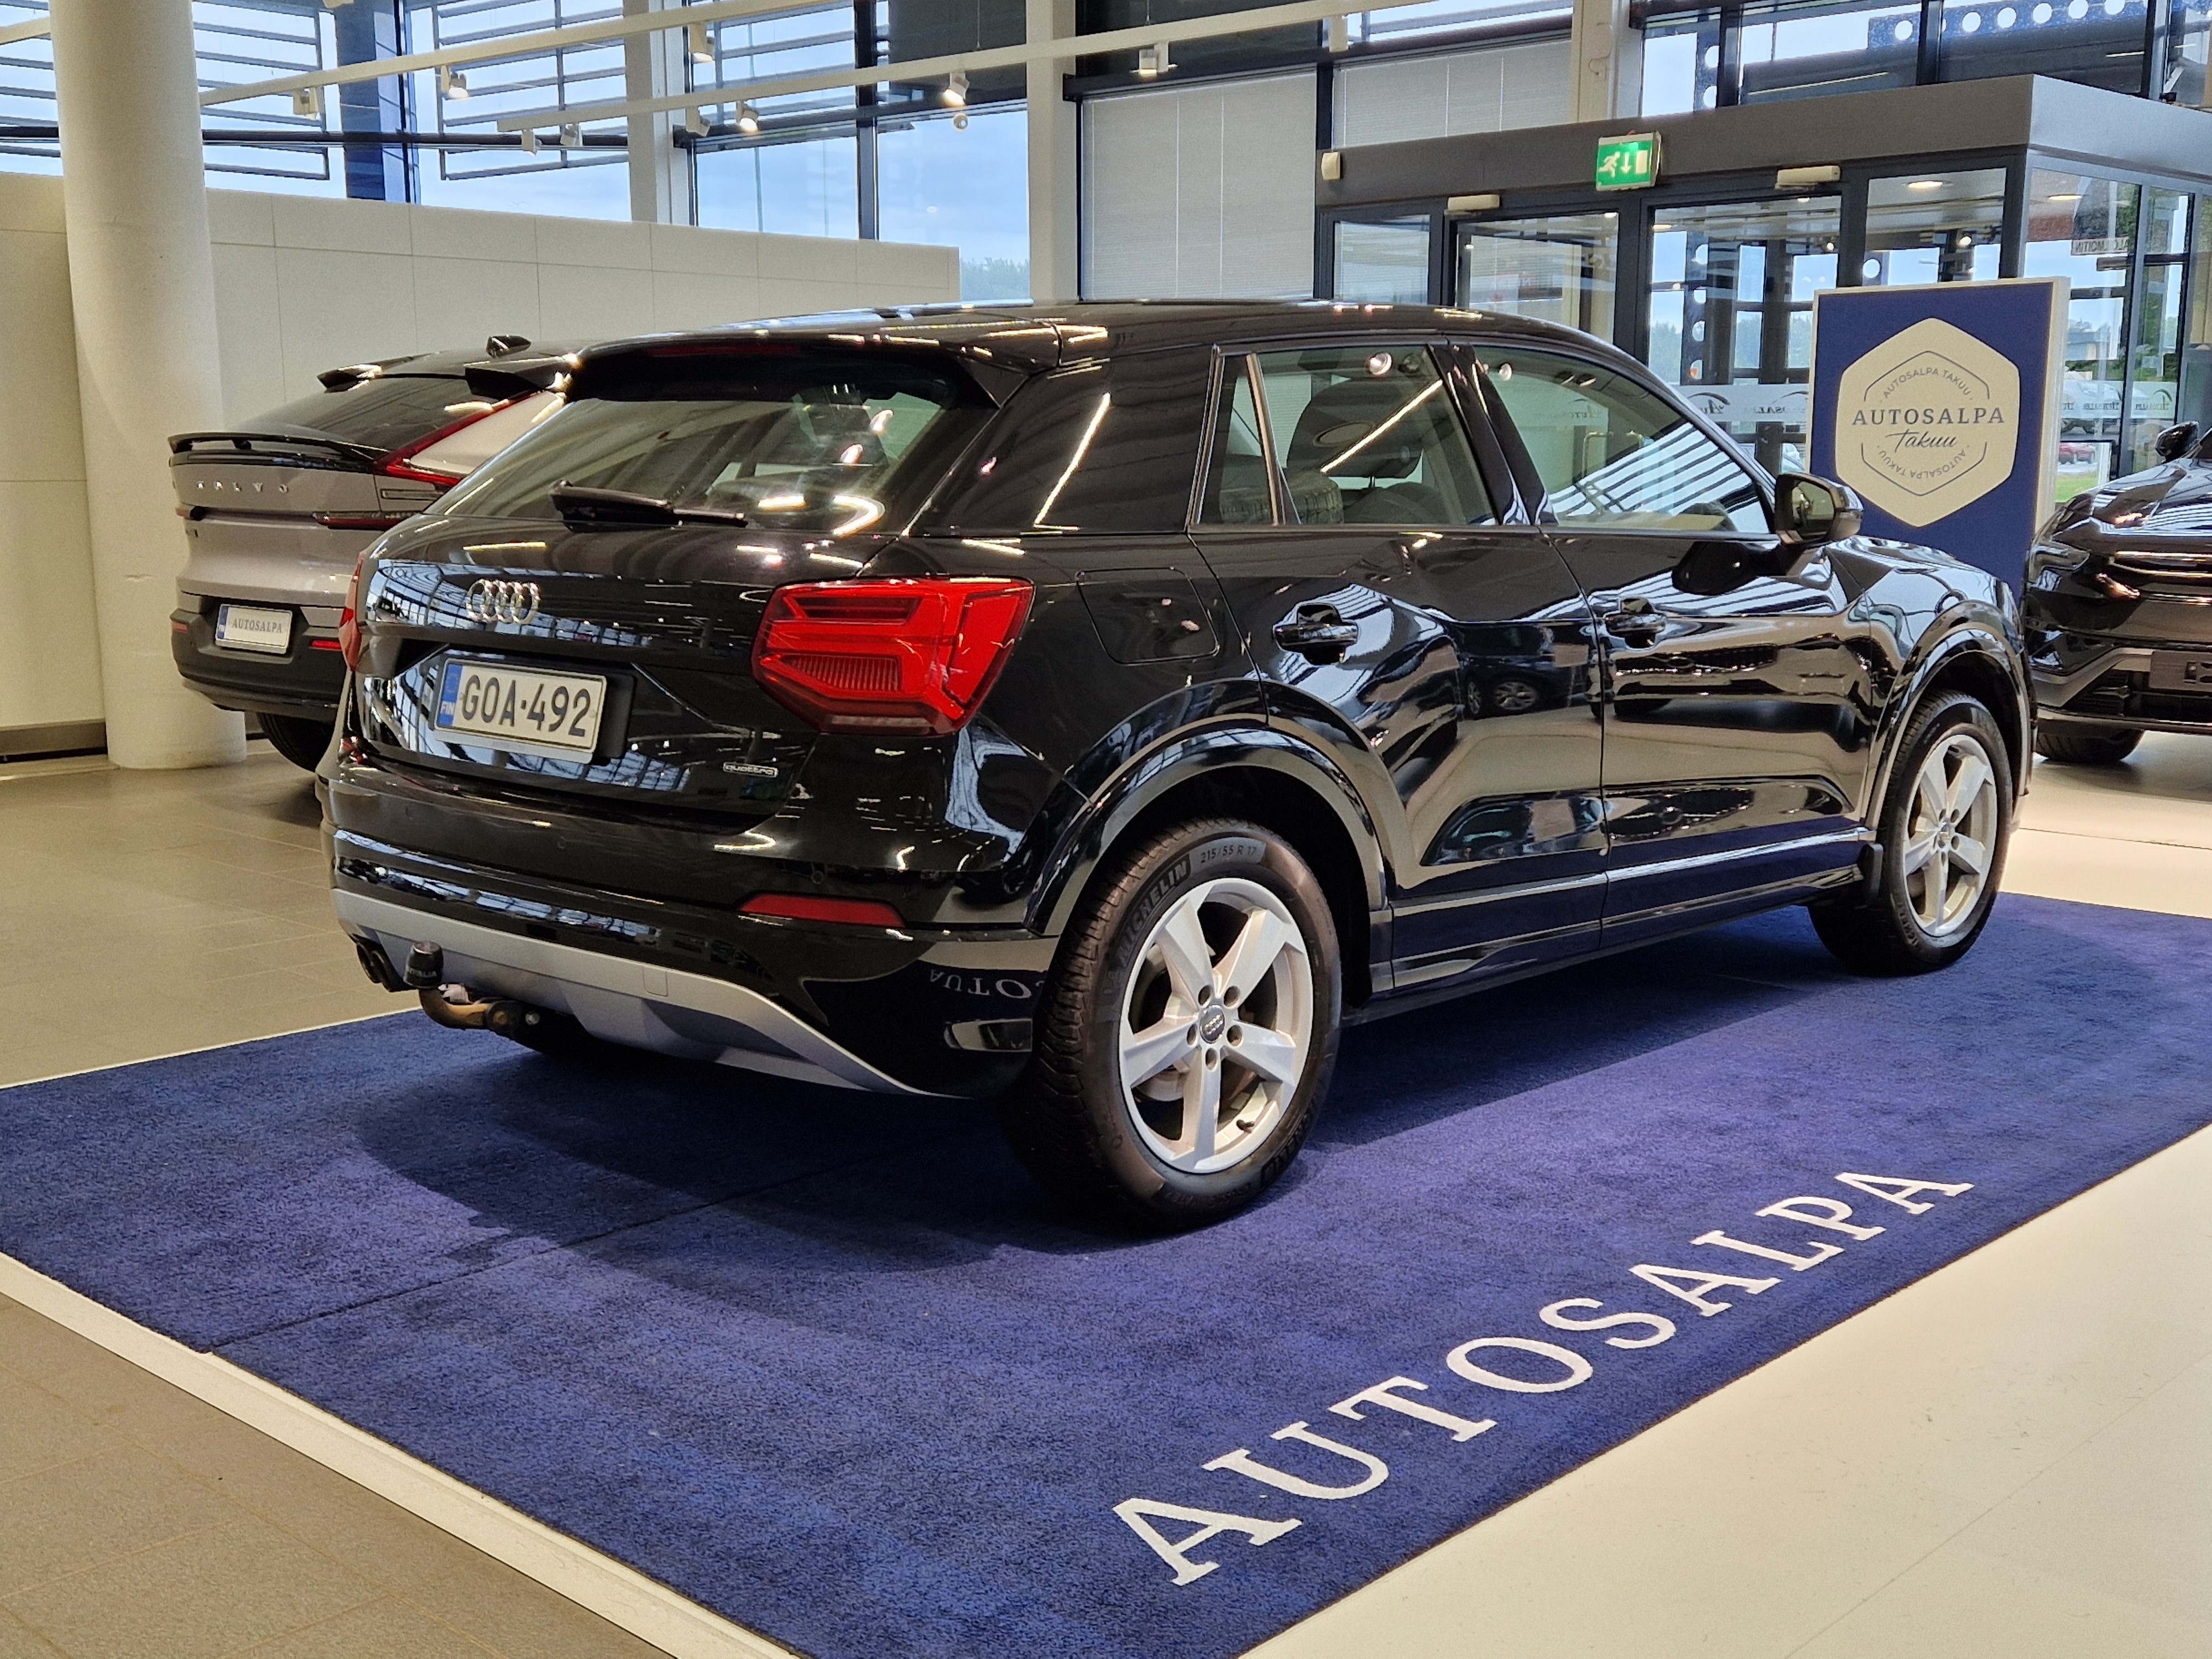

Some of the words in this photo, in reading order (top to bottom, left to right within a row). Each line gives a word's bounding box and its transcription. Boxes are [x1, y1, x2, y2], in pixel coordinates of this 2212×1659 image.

[1883, 367, 1938, 398] AUTOSALPA
[1943, 369, 1971, 395] TAKUU
[1851, 407, 2005, 425] AUTOSALPA
[1885, 428, 1957, 453] Takuu
[1878, 450, 1906, 476] TAKUU
[1910, 450, 1966, 479] AUTOSALPA
[231, 618, 283, 633] AUTOSALPA
[441, 701, 455, 716] FIN
[725, 765, 774, 775] quattro
[1201, 845, 1234, 863] 215/55
[1238, 844, 1244, 855] R
[1248, 846, 1257, 857] 17
[1114, 860, 1187, 967] MICHELIN
[1112, 1172, 1975, 1586] AUTOSALPA
